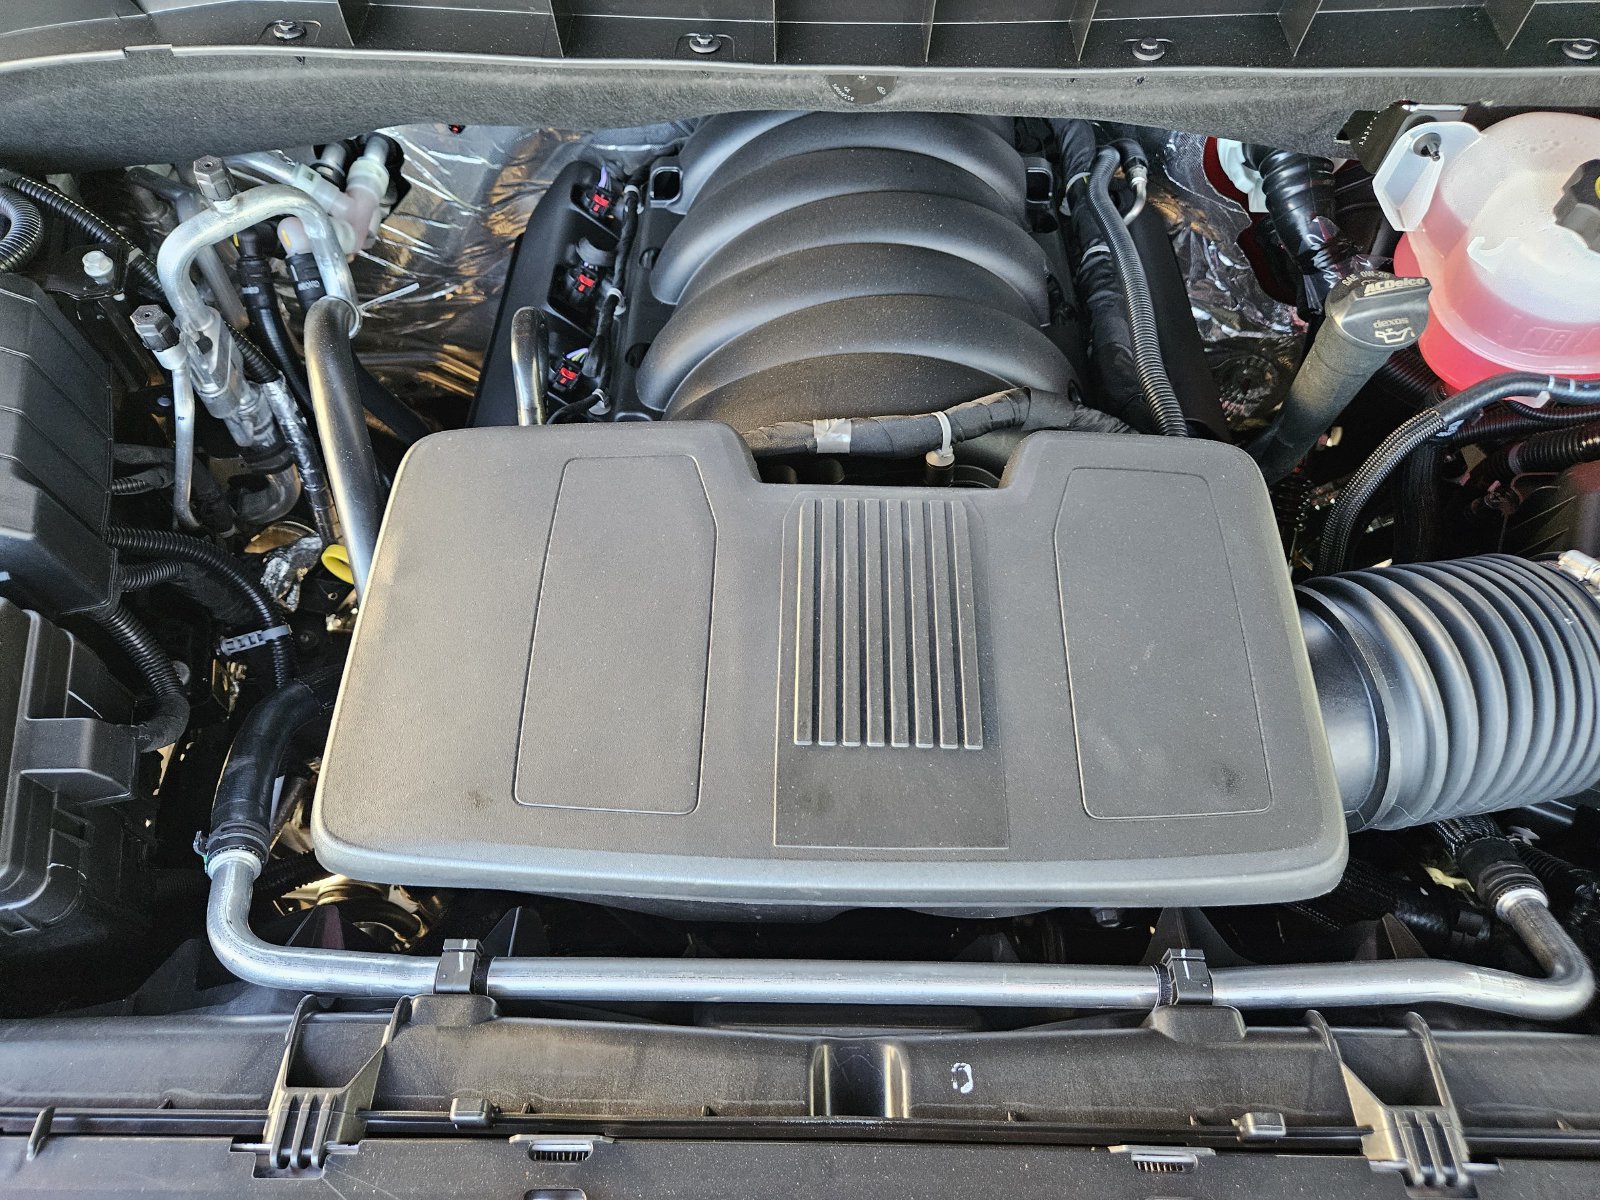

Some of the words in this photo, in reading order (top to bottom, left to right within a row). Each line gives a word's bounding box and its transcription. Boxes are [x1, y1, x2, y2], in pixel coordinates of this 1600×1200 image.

[1341, 273, 1359, 286] SAE
[1360, 270, 1390, 280] 0W-20
[1364, 277, 1426, 294] ACDelco
[1373, 317, 1409, 328] dexos
